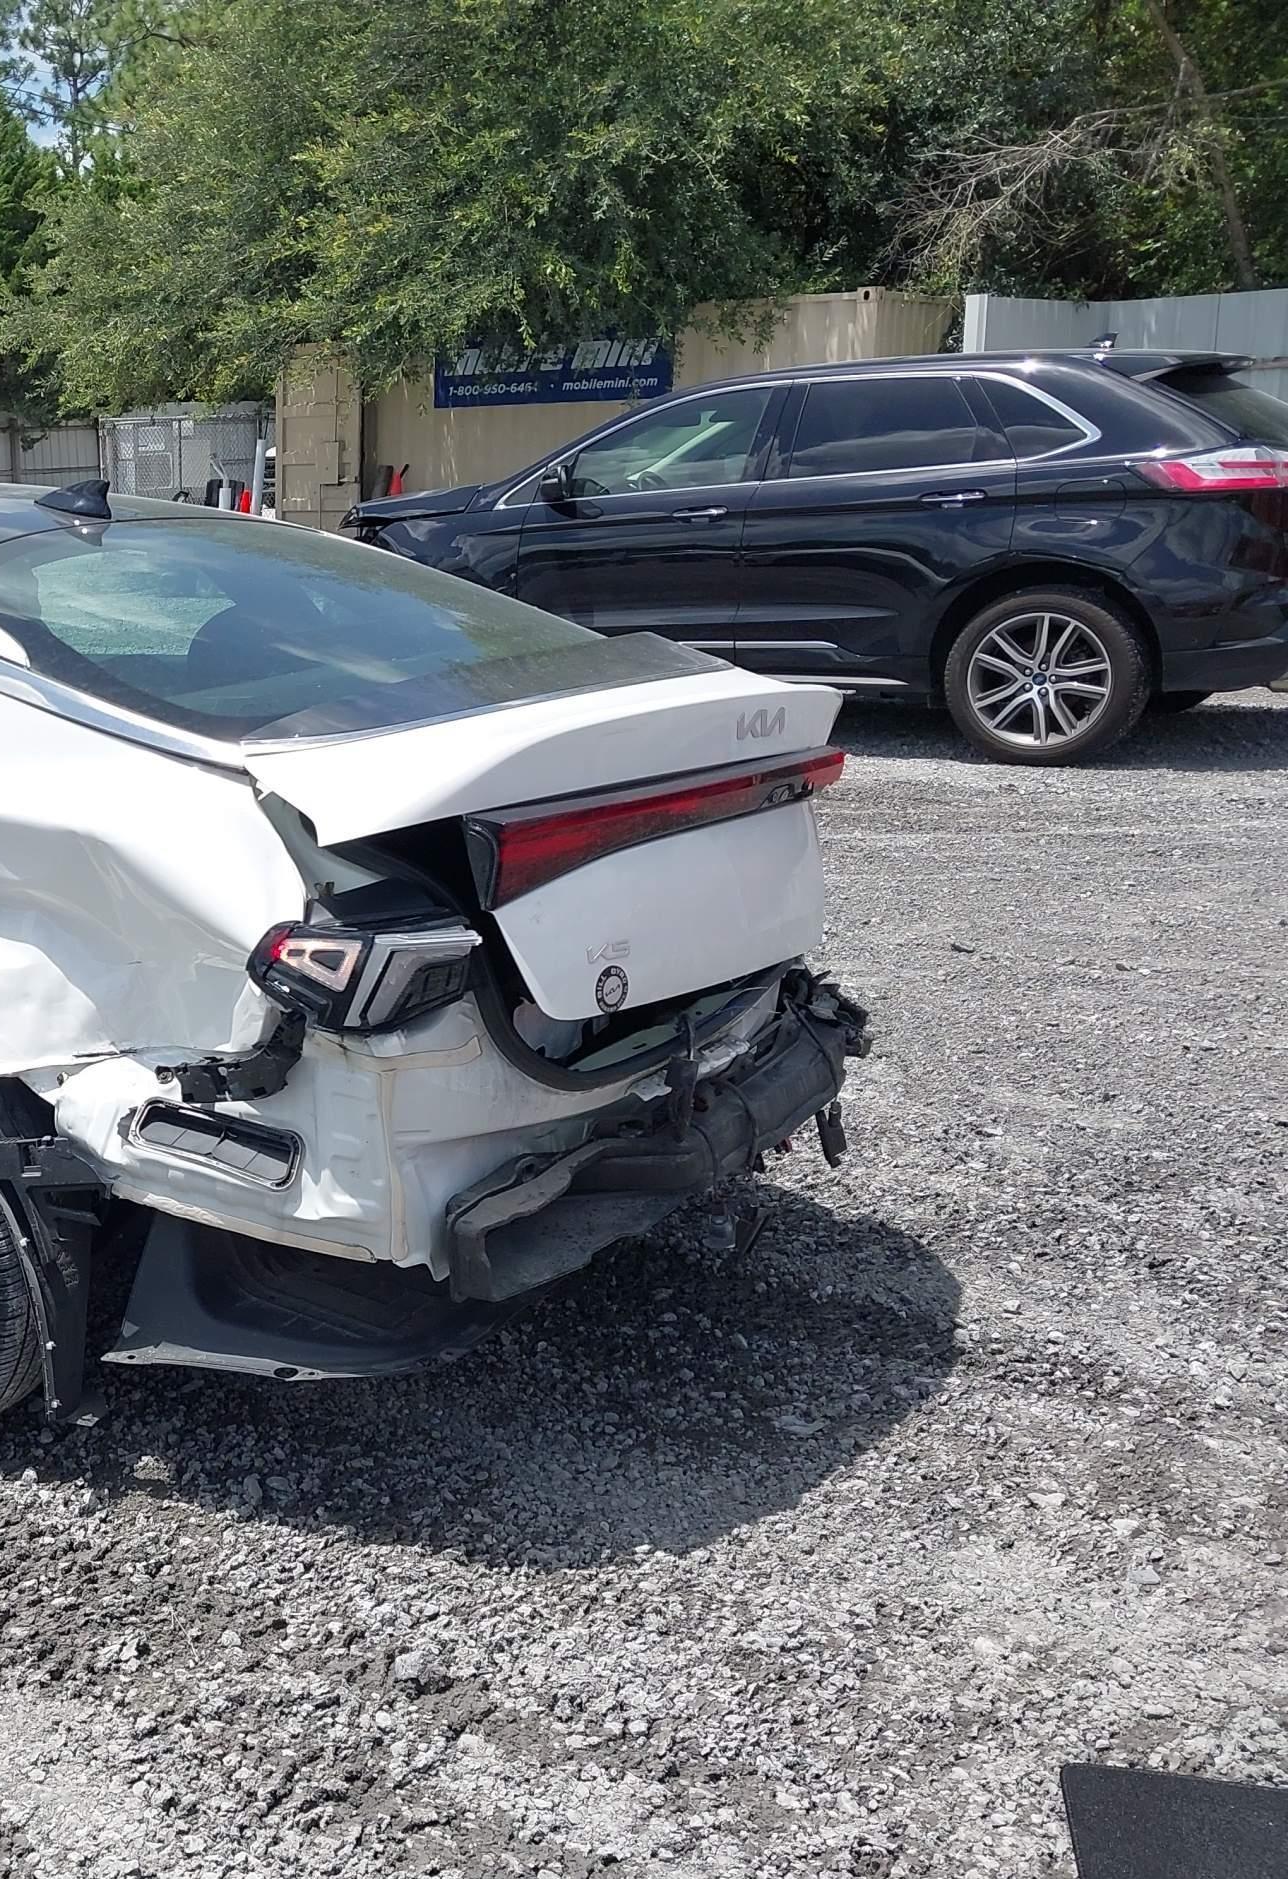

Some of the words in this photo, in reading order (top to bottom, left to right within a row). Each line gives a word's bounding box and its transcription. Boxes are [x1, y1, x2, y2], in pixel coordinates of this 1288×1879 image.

[562, 377, 658, 391] mobilemini.com
[736, 706, 786, 740] KIA
[585, 938, 631, 964] K5
